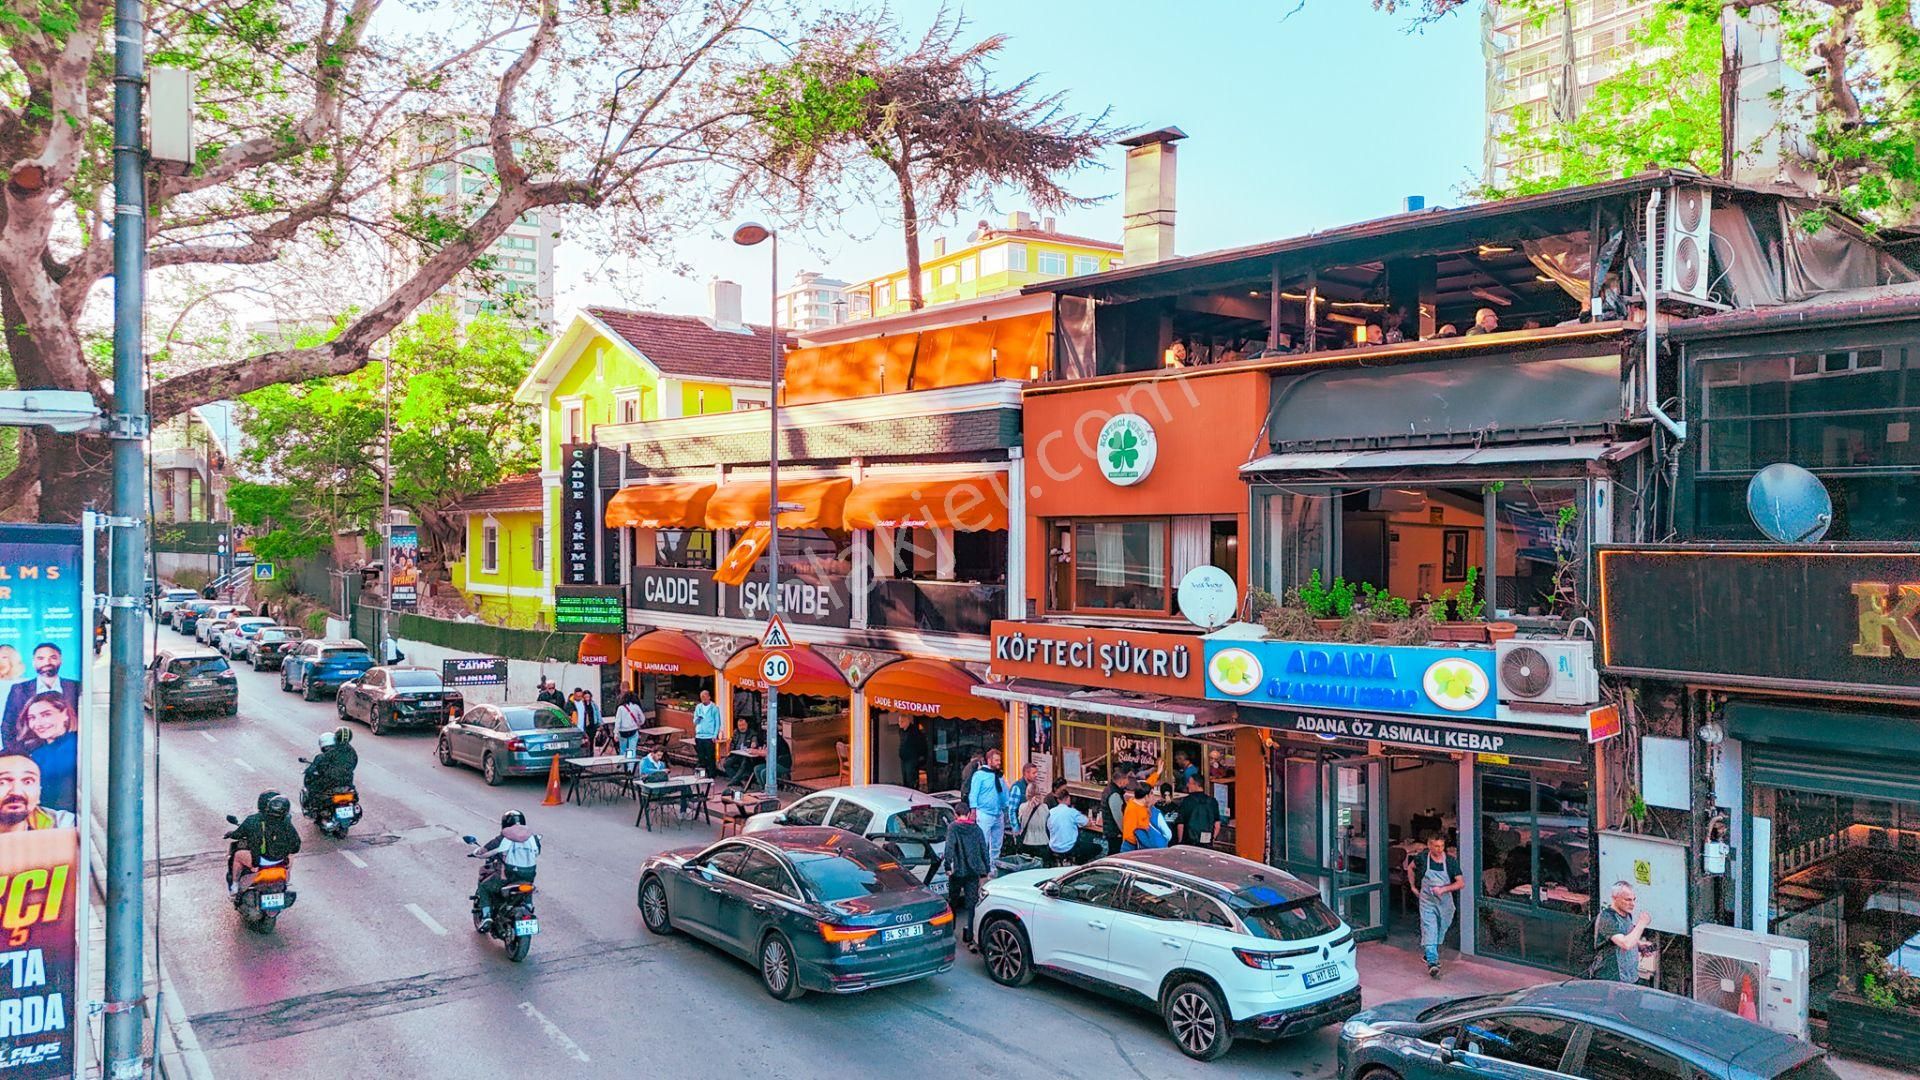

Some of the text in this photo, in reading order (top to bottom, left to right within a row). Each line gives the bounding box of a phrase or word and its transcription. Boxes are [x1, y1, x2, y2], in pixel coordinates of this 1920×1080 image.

[572, 450, 585, 500] CADDE
[570, 509, 587, 582] İŞKEMBE
[644, 575, 700, 606] CADDE
[644, 663, 679, 672] LAHMACUN
[996, 632, 1189, 679] KÖFTECİ ŞÜKRÜ
[1287, 650, 1397, 679] ADANA
[766, 661, 787, 676] 30
[1267, 677, 1292, 699] ÖZ
[874, 696, 941, 713] CADDE RESTORANT
[1296, 716, 1504, 751] ADANA ÖZ ASMALI KEBAP
[886, 931, 895, 940] 34
[898, 928, 910, 937] SMZ
[913, 926, 922, 934] 31
[11, 1041, 61, 1060] FILMS
